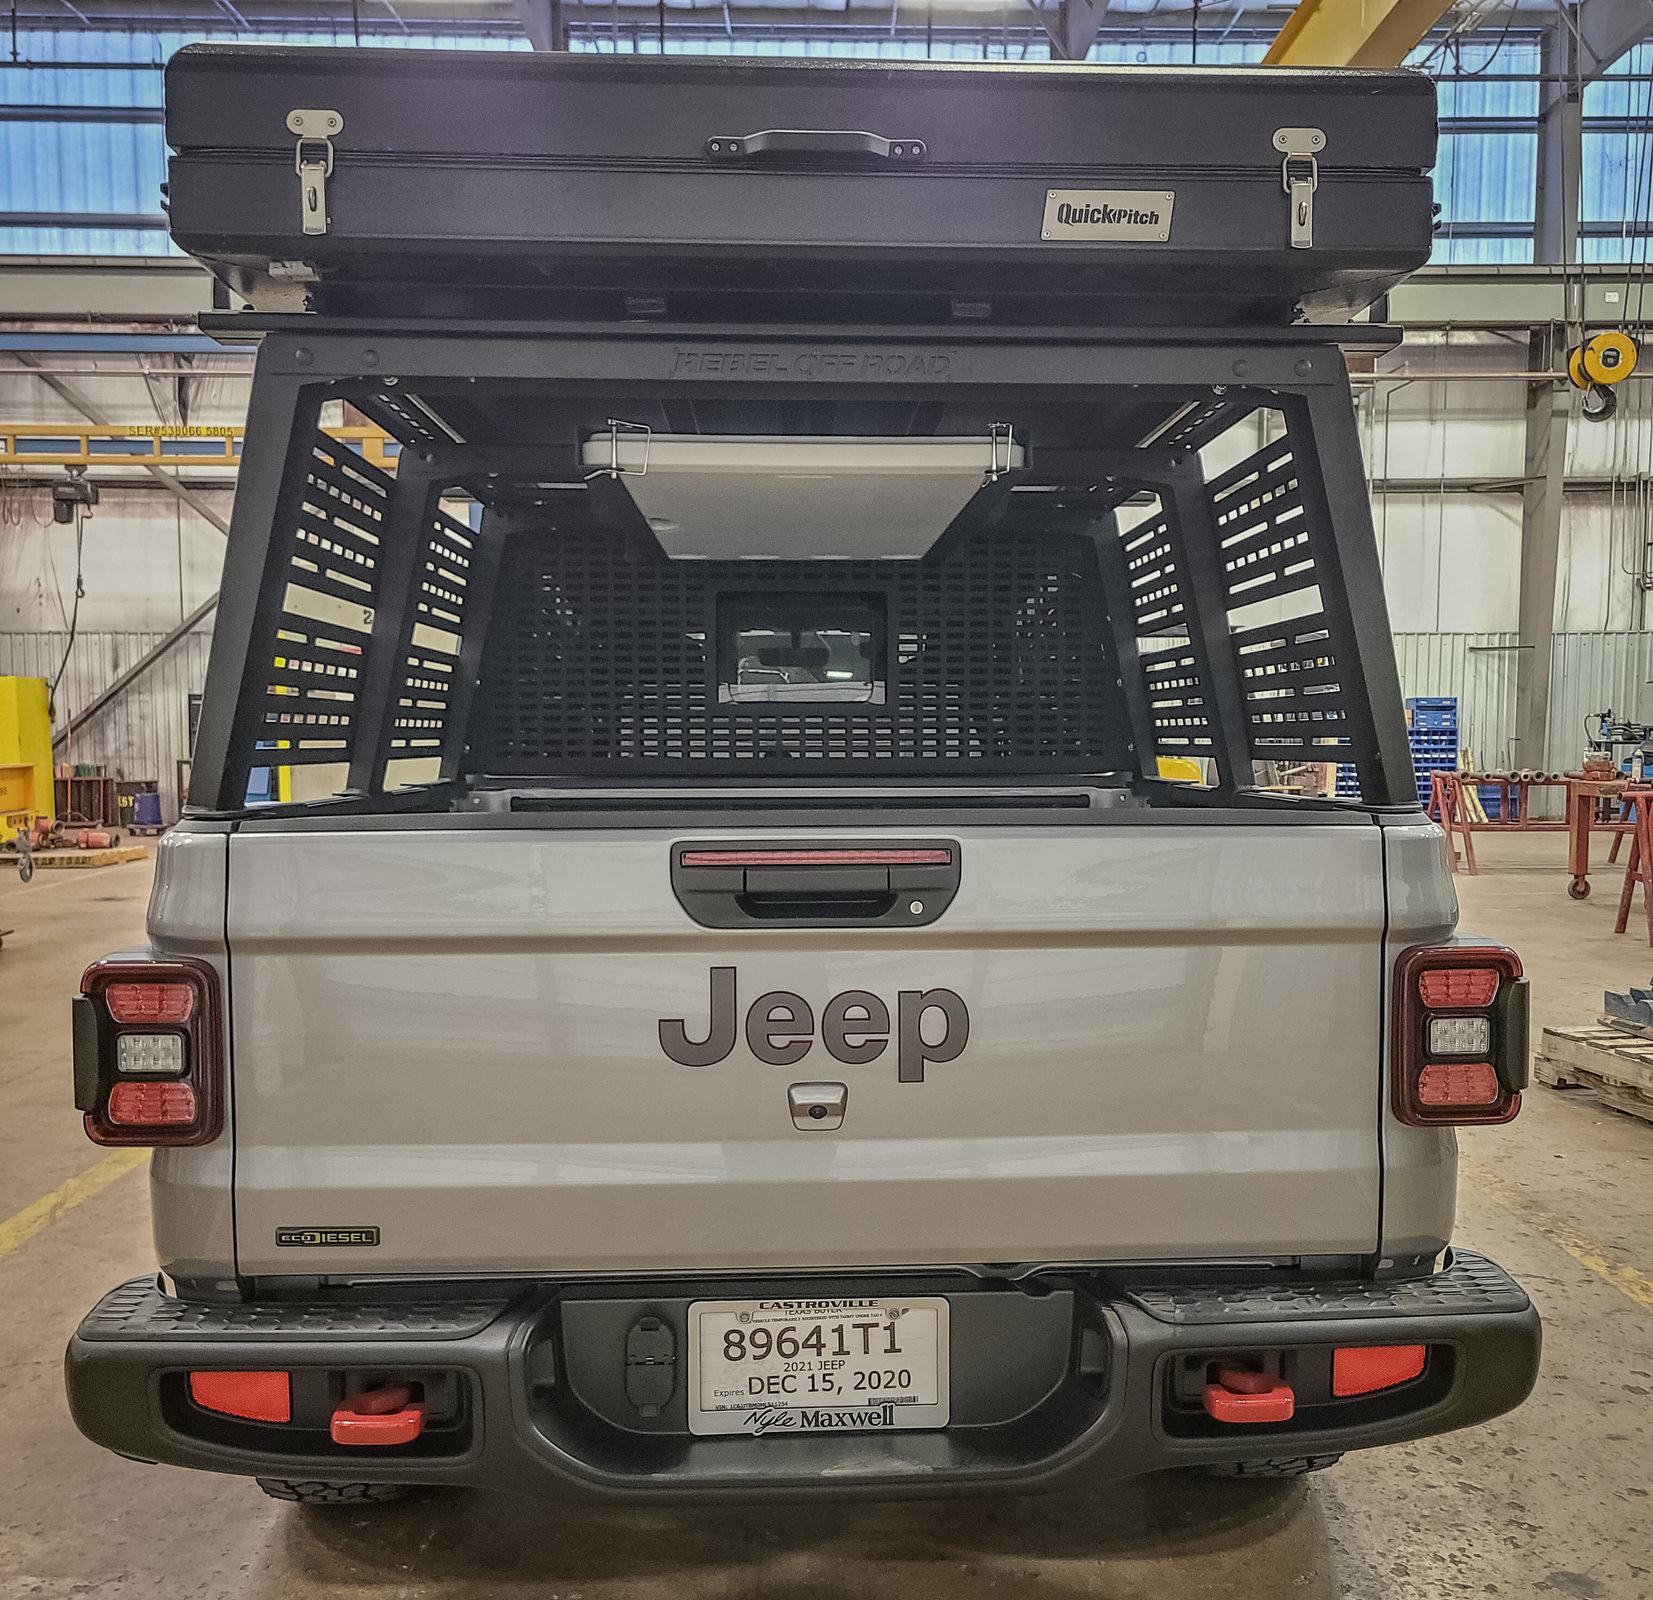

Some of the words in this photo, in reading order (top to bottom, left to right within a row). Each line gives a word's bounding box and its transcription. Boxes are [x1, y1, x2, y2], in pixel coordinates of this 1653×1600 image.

[795, 352, 857, 376] OFF
[206, 426, 234, 437] 5805
[658, 966, 970, 1083] Jeep
[759, 1300, 879, 1310] CASTROVILLE
[722, 1321, 902, 1362] 89641T1
[783, 1361, 813, 1372] 2021
[817, 1360, 846, 1371] JEEP
[713, 1388, 744, 1398] Expires
[748, 1375, 797, 1396] DEC
[807, 1373, 844, 1396] 15,
[853, 1369, 912, 1391] 2020
[743, 1409, 797, 1433] Nyle
[800, 1405, 895, 1428] Maxwell
